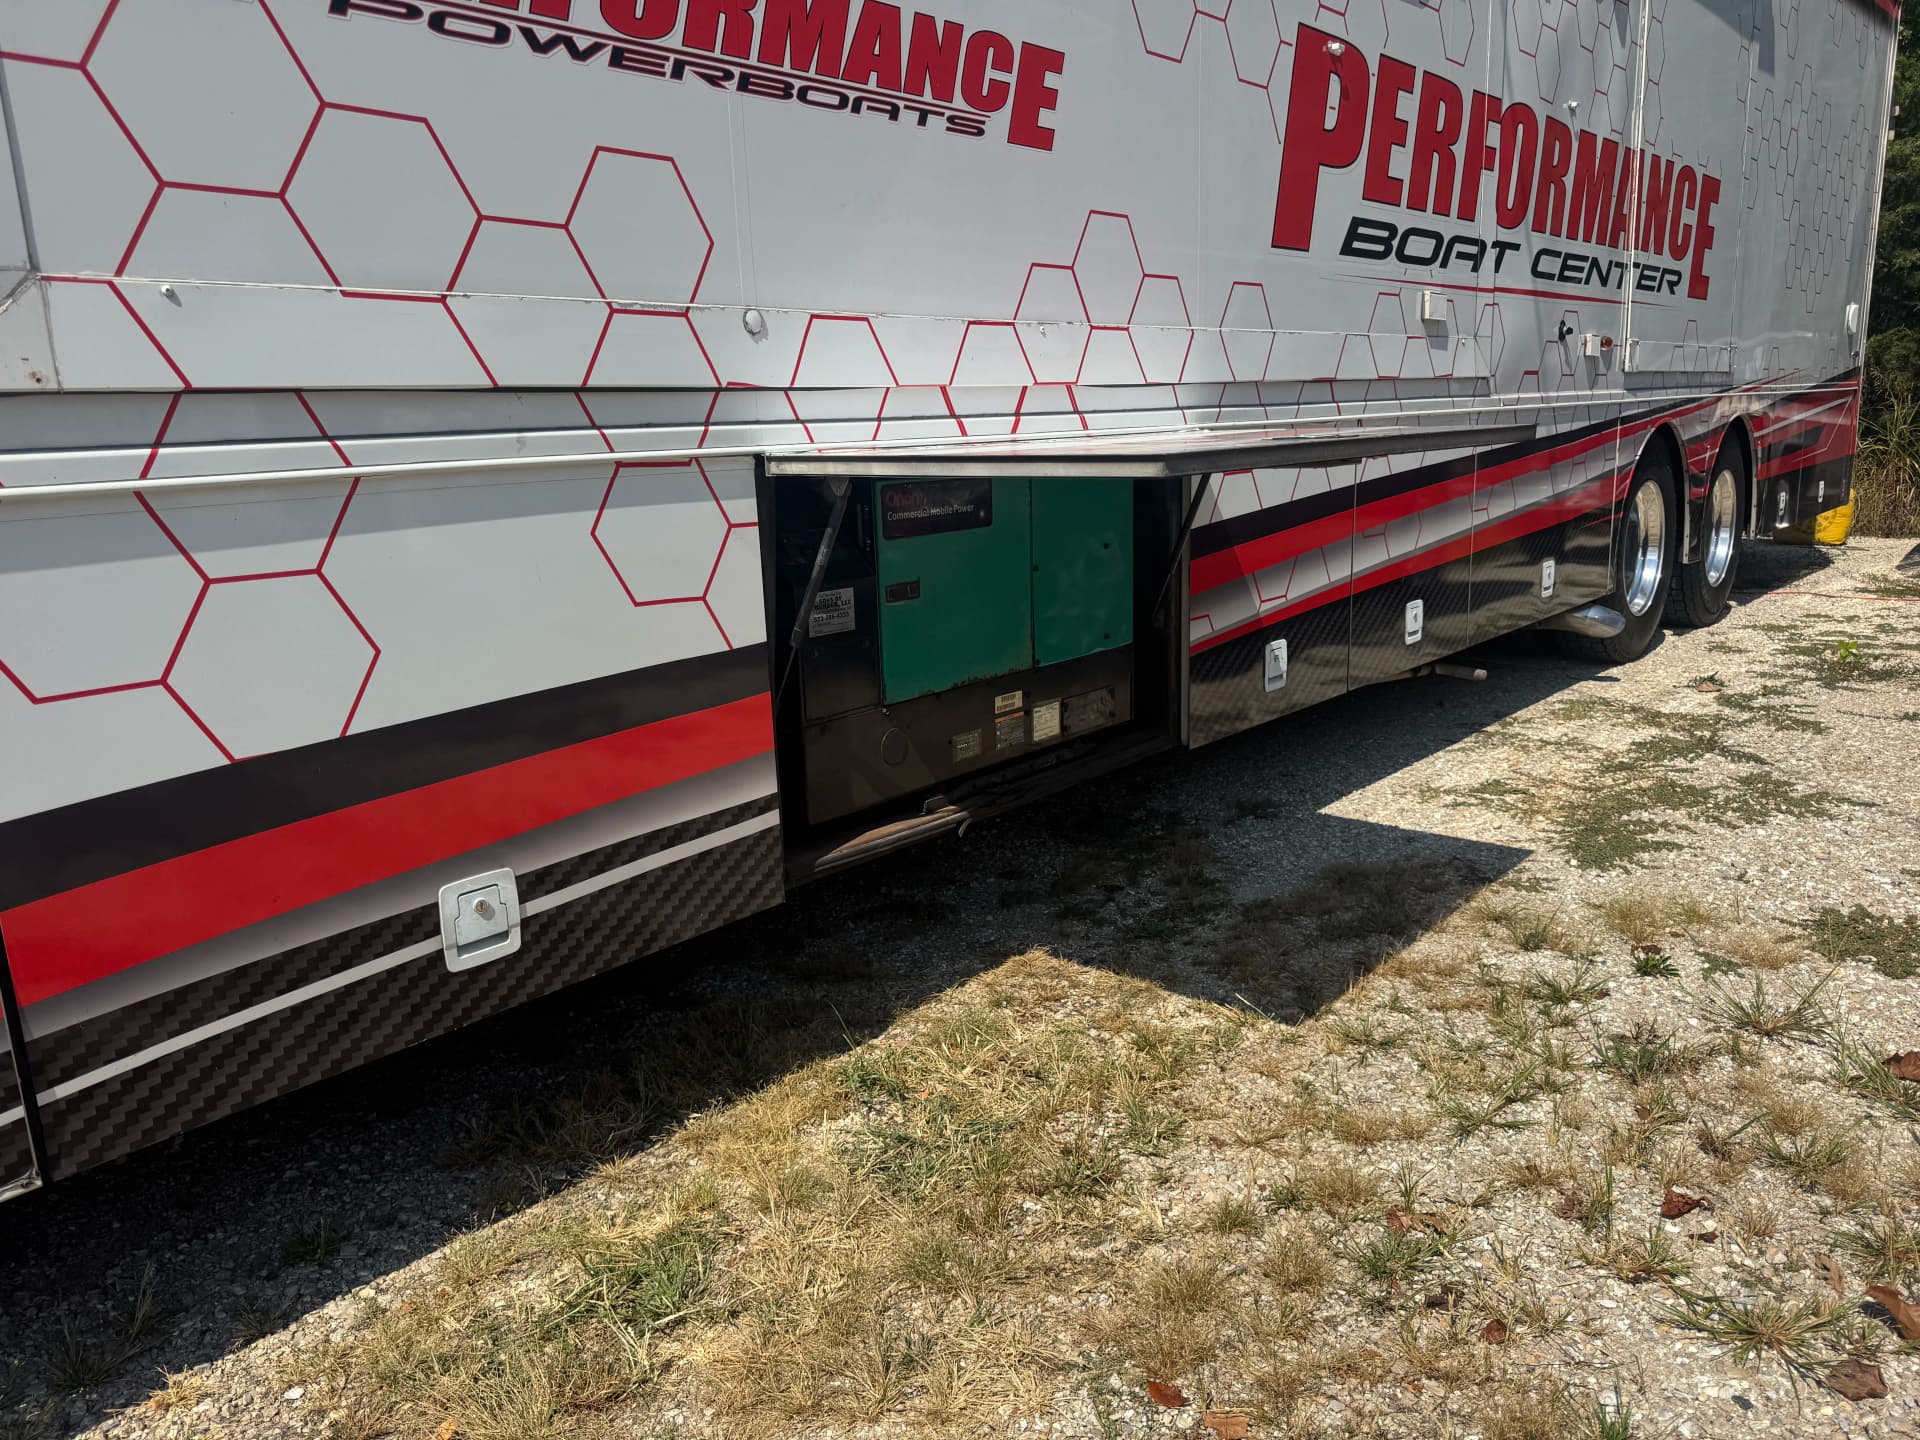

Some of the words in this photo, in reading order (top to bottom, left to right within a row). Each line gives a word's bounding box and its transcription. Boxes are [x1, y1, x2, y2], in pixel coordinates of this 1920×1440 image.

[327, 0, 988, 137] POWERBOATS
[1272, 22, 1721, 300] PERFORMANCE
[1339, 216, 1520, 273] BOAT
[1531, 247, 1682, 295] CENTER
[887, 506, 929, 521] Commercial
[930, 504, 952, 517] Mobile
[953, 502, 976, 514] Power
